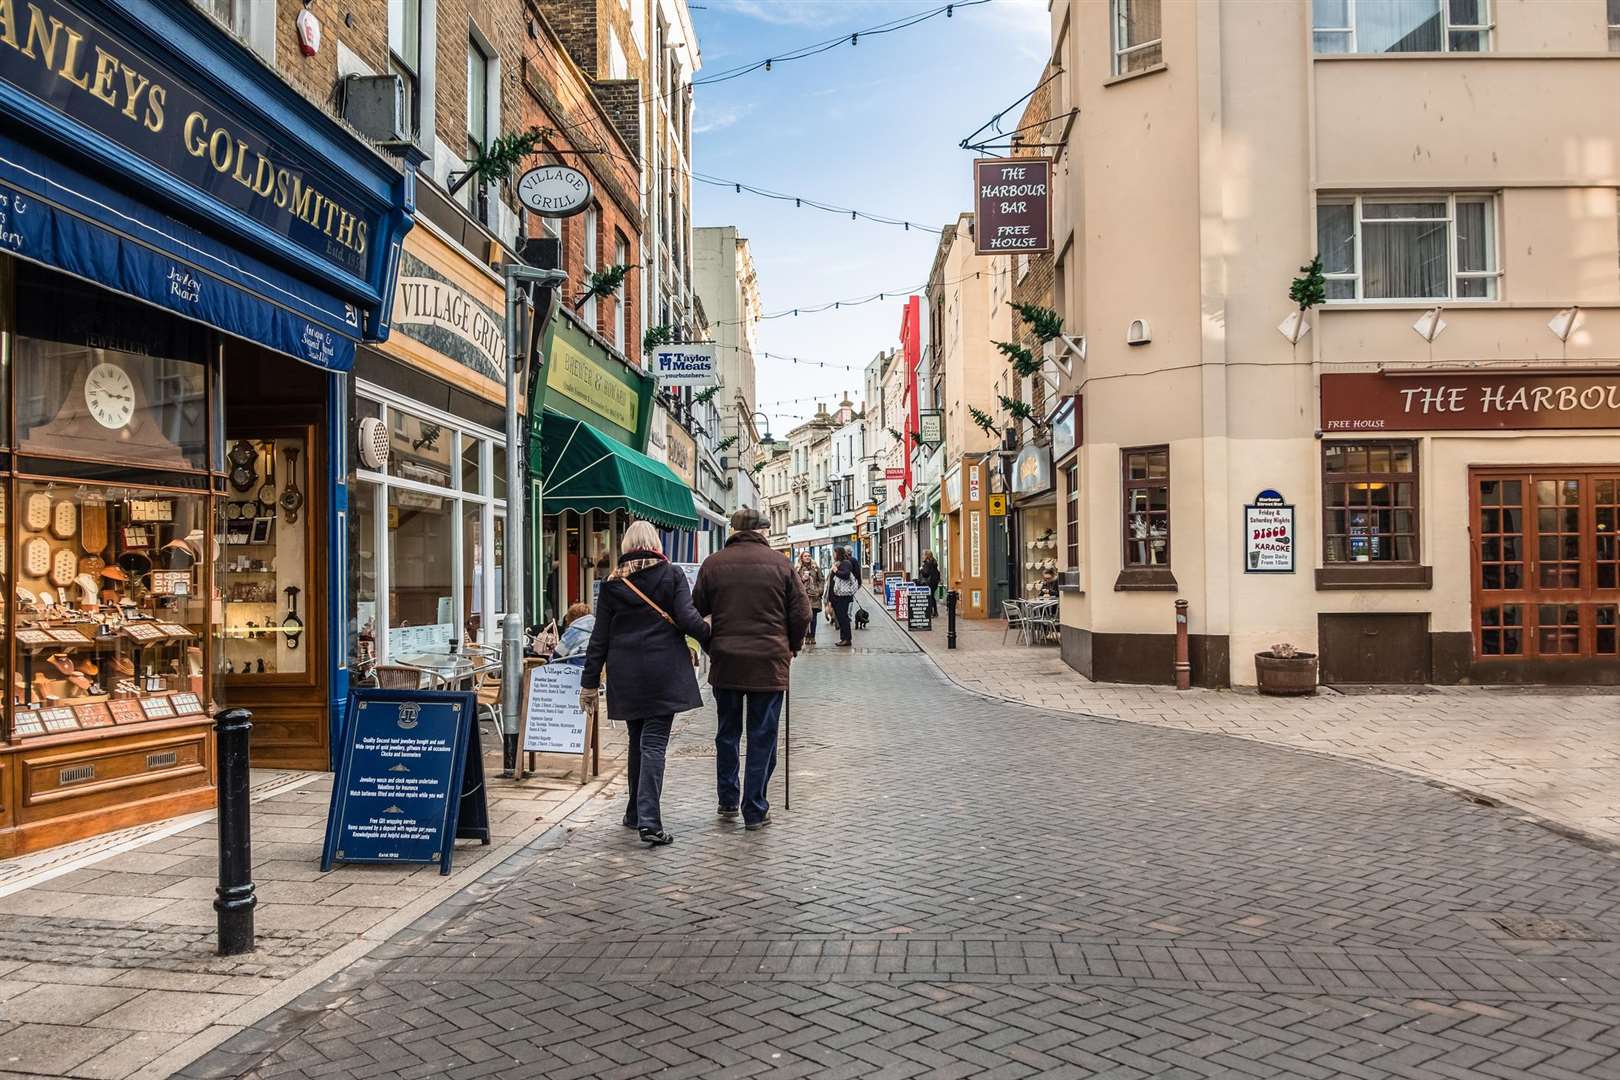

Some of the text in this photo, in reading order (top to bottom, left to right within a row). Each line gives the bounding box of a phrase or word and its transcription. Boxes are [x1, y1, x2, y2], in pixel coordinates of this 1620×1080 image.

[1001, 167, 1027, 180] THE
[183, 111, 368, 254] GOLDSMITHS
[522, 170, 584, 191] VILLAGE
[981, 184, 1046, 198] HARBOUR
[531, 193, 576, 208] GRILL
[1000, 201, 1027, 214] BAR
[997, 225, 1031, 236] FREE
[991, 237, 1037, 248] HOUSE
[400, 283, 471, 334] VILLAGE
[674, 353, 711, 363] Taylor
[672, 362, 711, 370] Meats
[1400, 386, 1468, 414] THE
[1328, 420, 1385, 429] FREE HOUSE
[1273, 517, 1290, 525] Nights
[1253, 526, 1286, 540] DISCO
[1255, 543, 1290, 552] KARAOKE
[544, 666, 562, 675] Village
